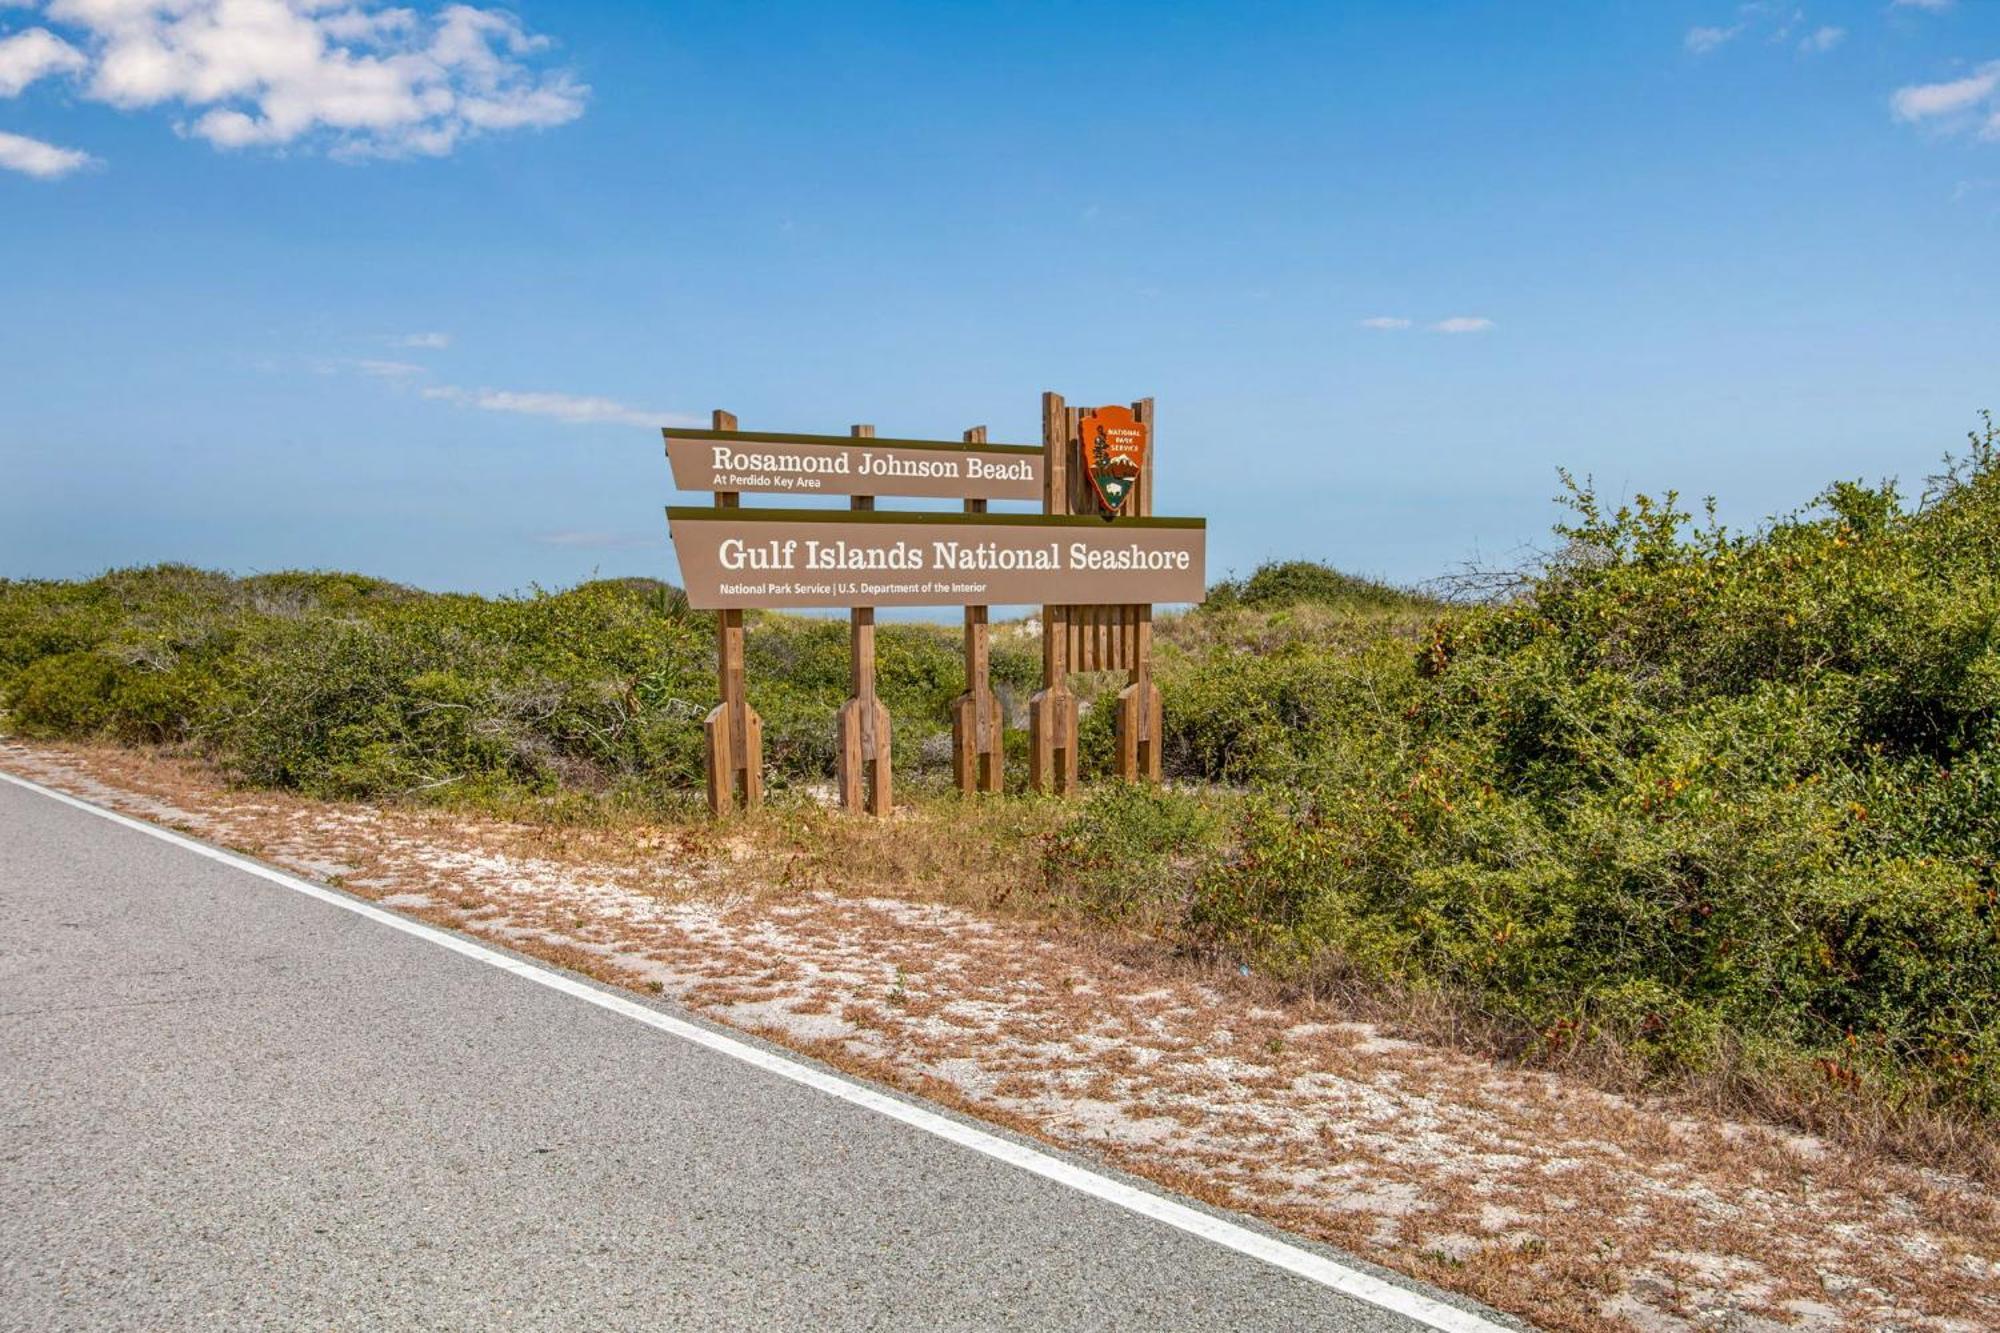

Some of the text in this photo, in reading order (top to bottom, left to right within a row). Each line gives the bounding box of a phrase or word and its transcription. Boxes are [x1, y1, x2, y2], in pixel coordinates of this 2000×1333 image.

[1107, 428, 1142, 436] NATIONAL
[1110, 444, 1139, 452] SERVICE
[712, 447, 1034, 481] Rosamond Johnson Beach
[713, 474, 821, 489] At Perdido Key Area
[719, 539, 1190, 570] Gulf Islands National Seashore
[719, 583, 767, 594] National
[769, 583, 792, 594] Park
[794, 583, 831, 594] Service
[838, 583, 858, 594] U.S.
[861, 583, 919, 596] Department
[921, 583, 932, 594] of
[934, 582, 950, 593] the
[952, 582, 986, 593] Interior
